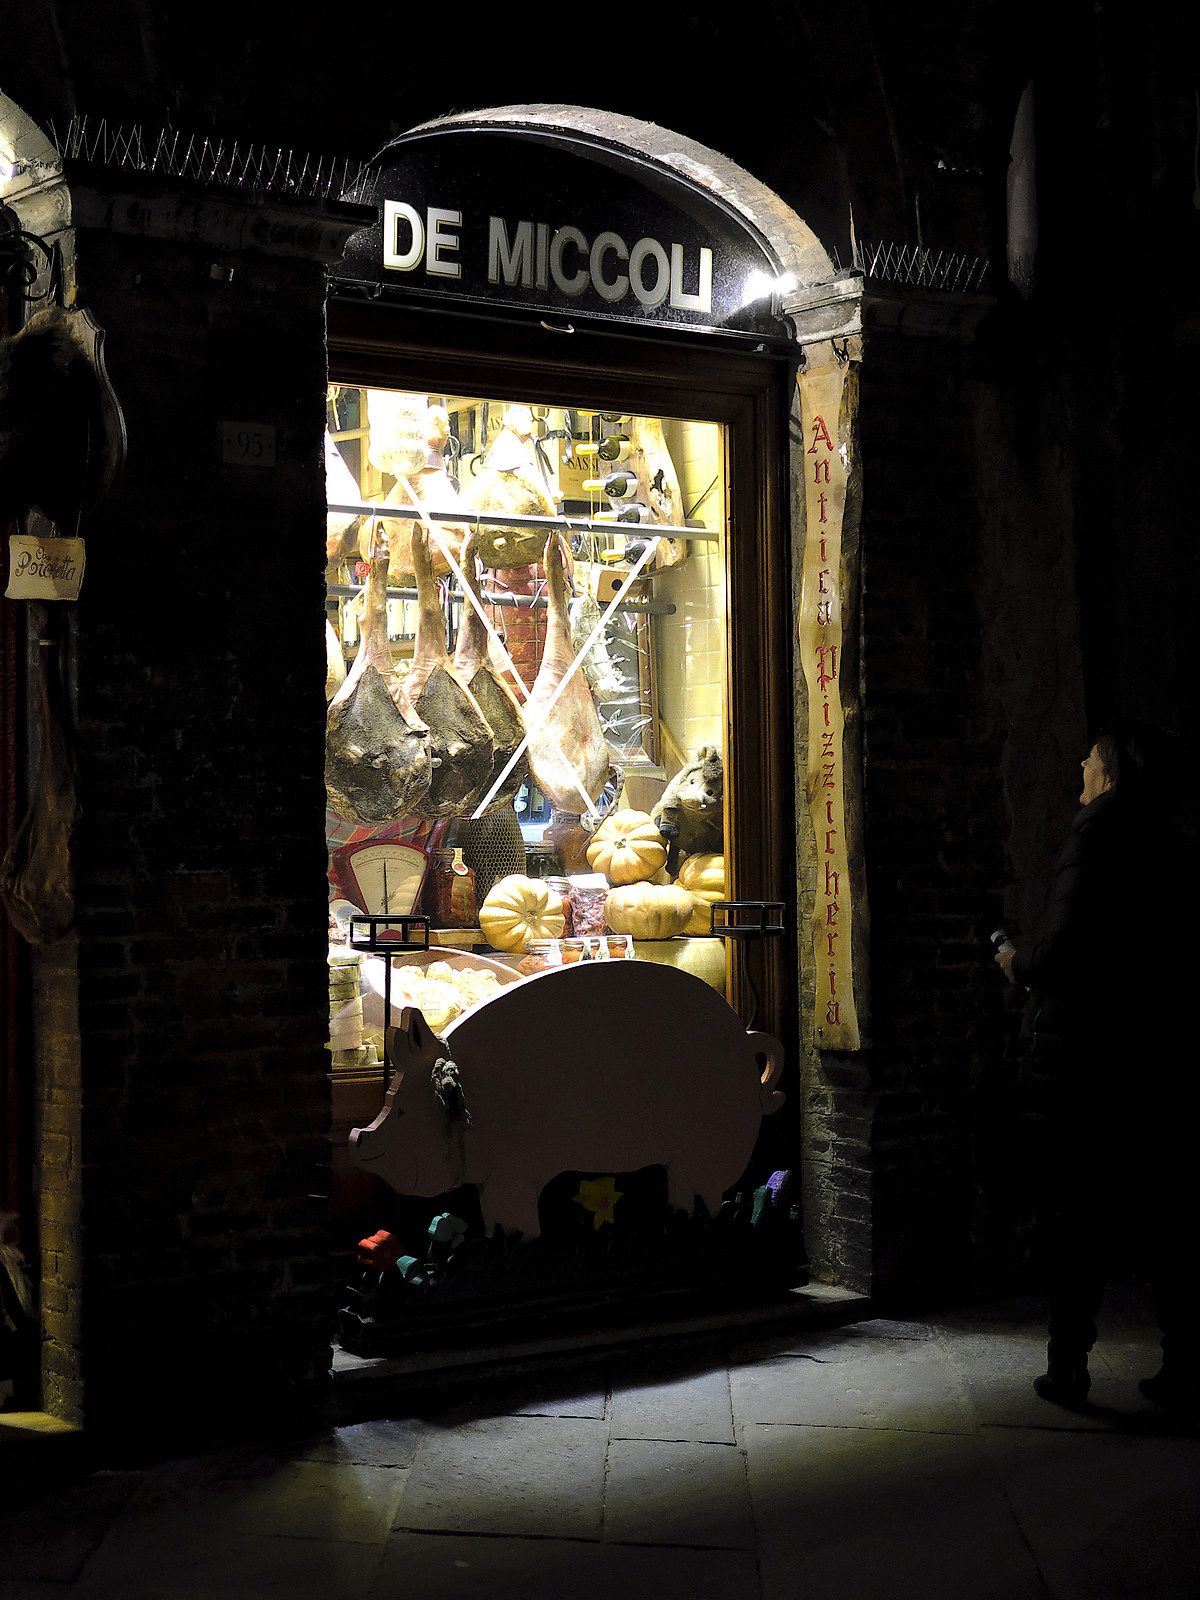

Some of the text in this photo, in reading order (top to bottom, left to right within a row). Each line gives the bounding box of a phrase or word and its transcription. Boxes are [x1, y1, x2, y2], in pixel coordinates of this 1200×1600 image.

[383, 199, 714, 314] DE MICCOLI
[237, 431, 263, 458] 95
[807, 415, 841, 1026] Antica Pizzicheria
